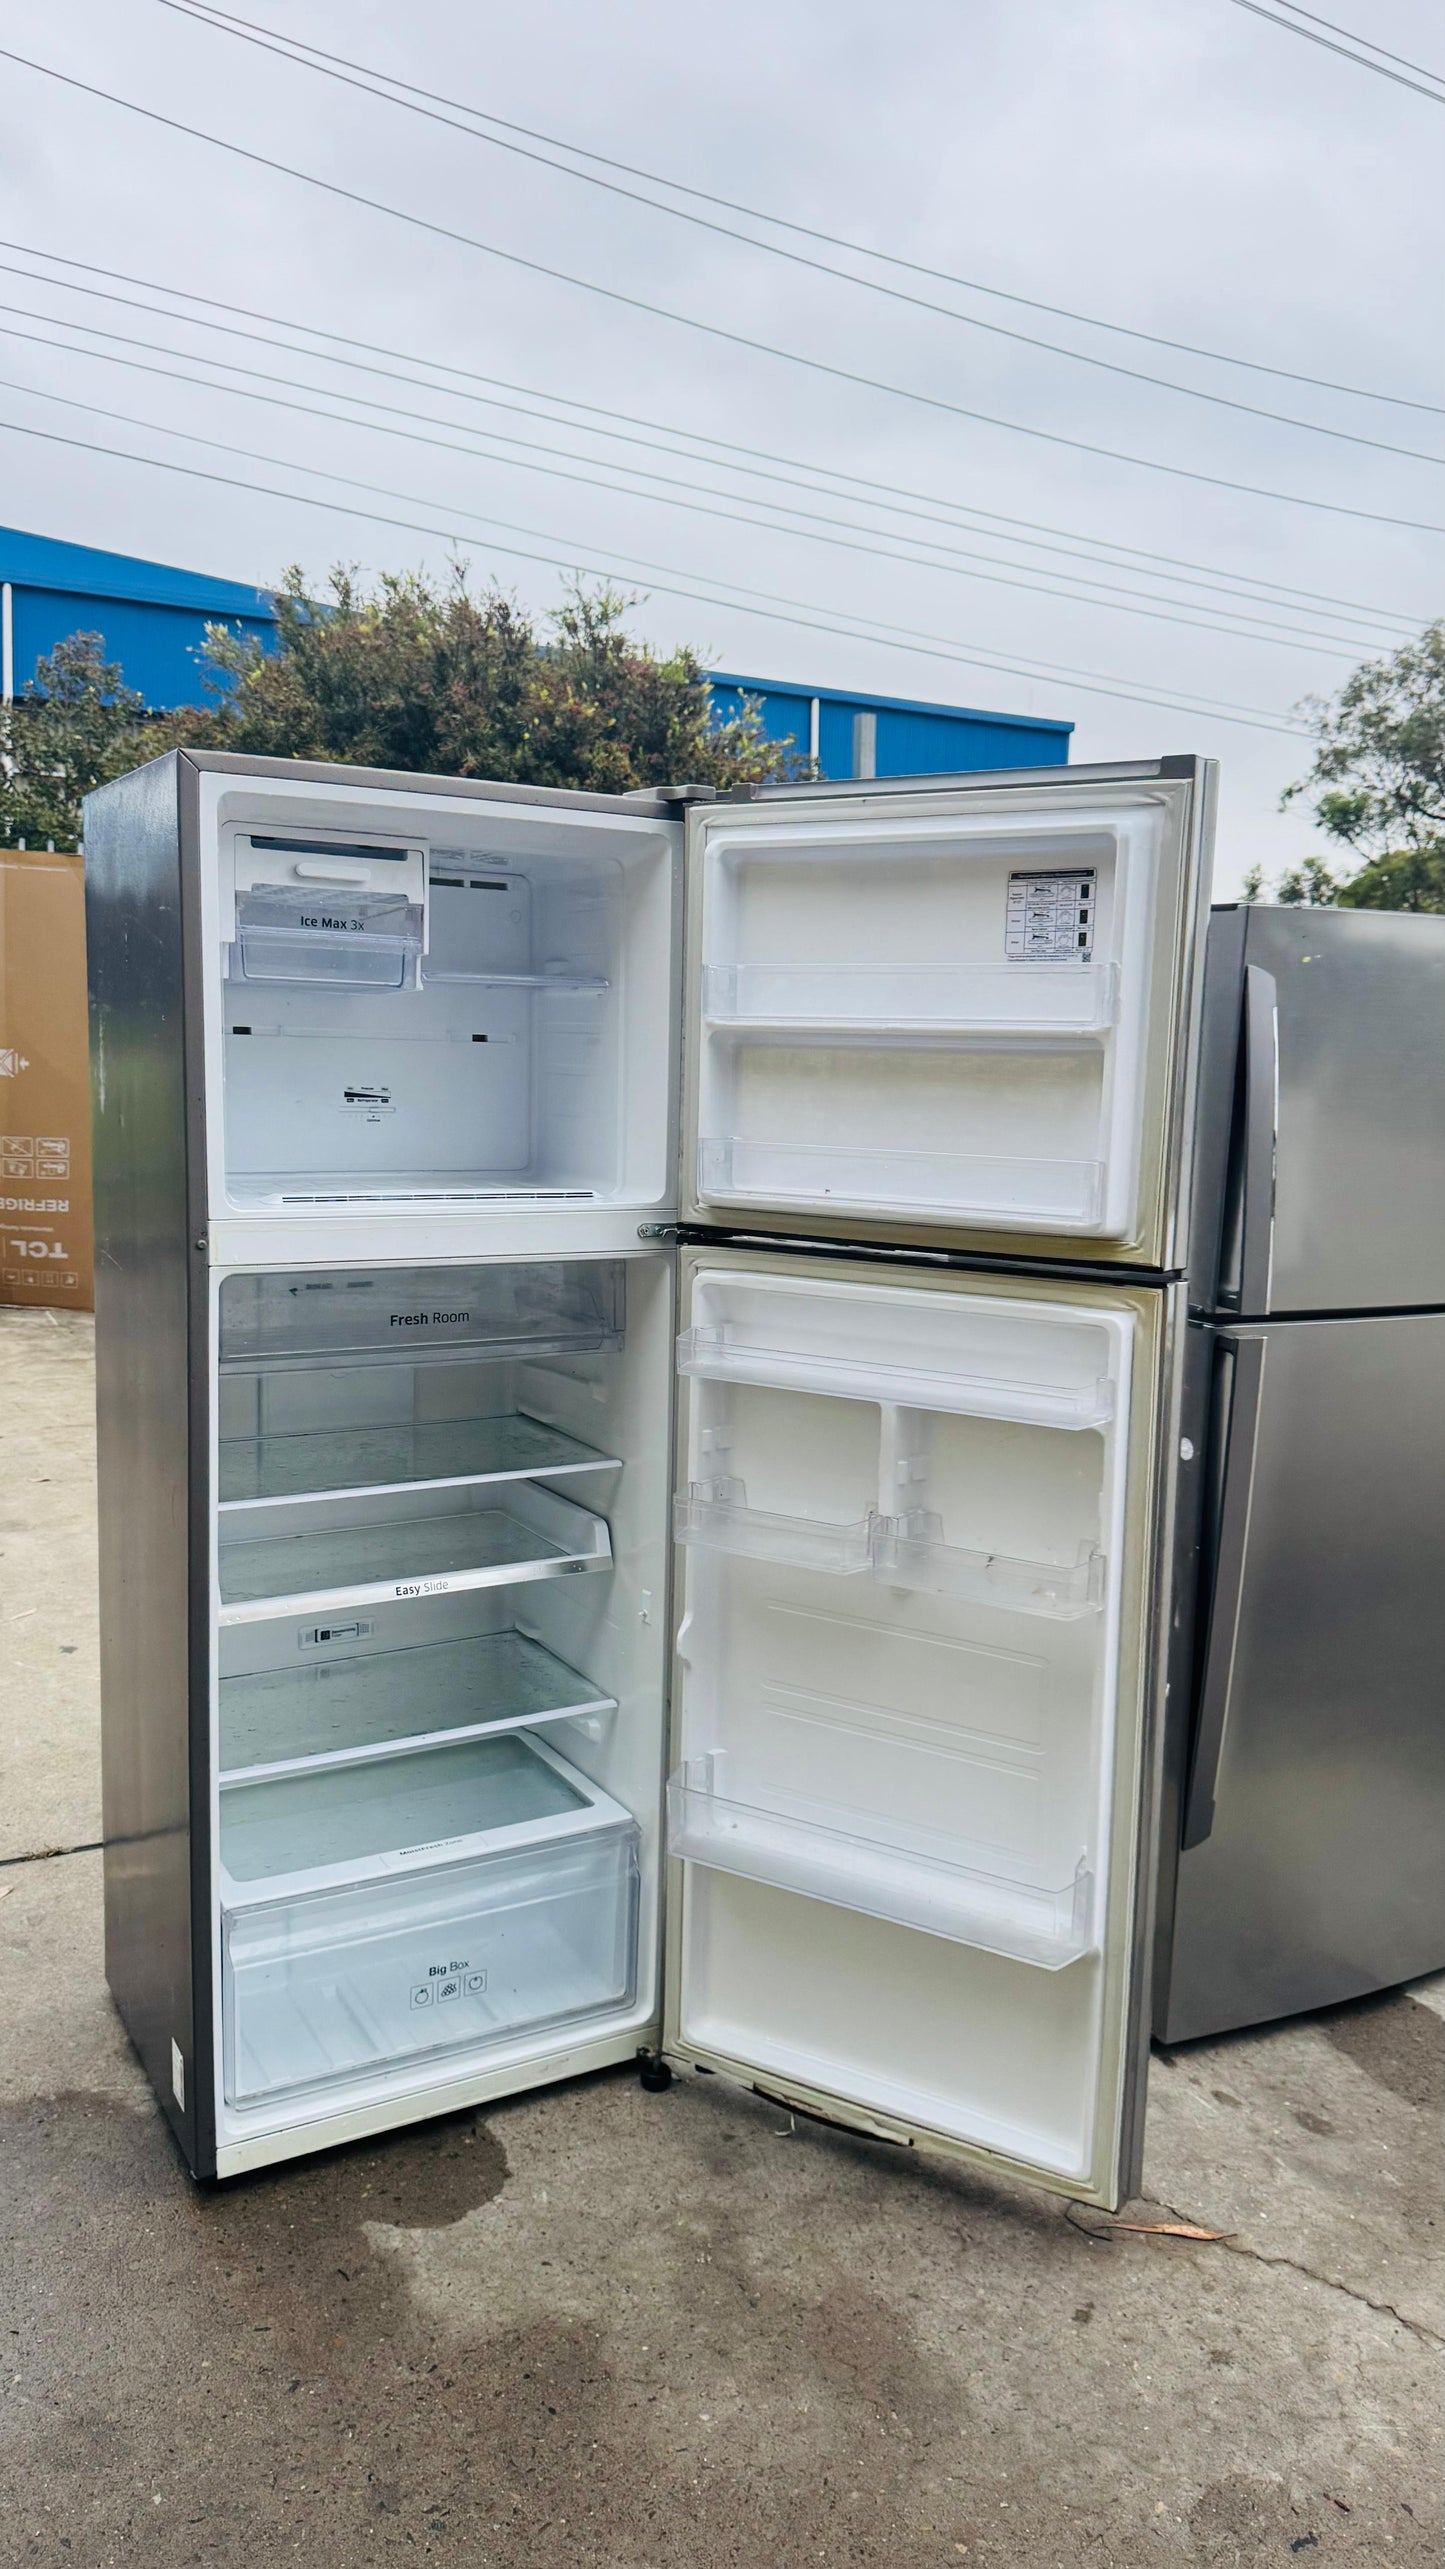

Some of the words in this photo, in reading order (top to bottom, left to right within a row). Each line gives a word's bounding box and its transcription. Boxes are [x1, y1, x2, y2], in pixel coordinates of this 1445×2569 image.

[301, 916, 318, 927] Ice
[322, 918, 347, 929] Max
[350, 920, 365, 931] 3x
[10, 1240, 69, 1258] TCL
[390, 1313, 428, 1326] Fresh
[433, 1312, 470, 1323] Room
[395, 1585, 421, 1596] Easy
[423, 1581, 449, 1592] Slide
[428, 1965, 447, 1977] Big
[449, 1960, 470, 1972] Box
